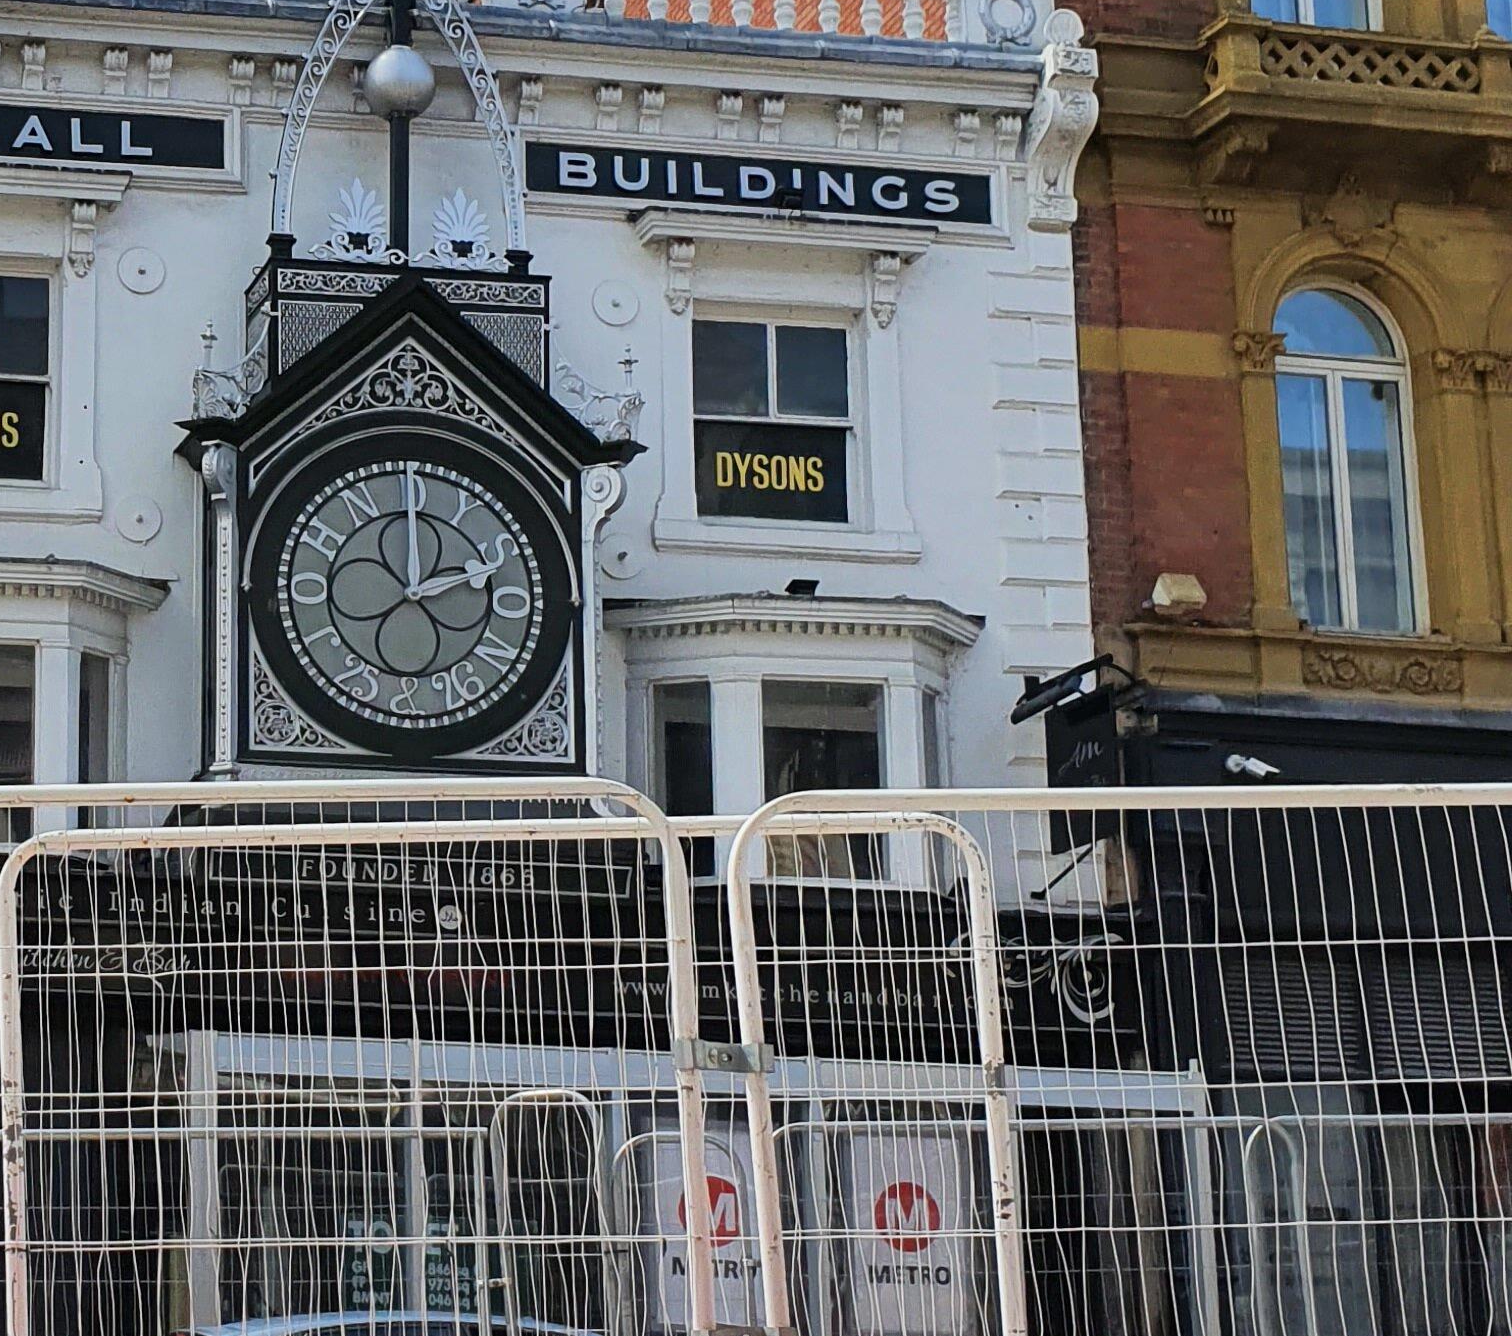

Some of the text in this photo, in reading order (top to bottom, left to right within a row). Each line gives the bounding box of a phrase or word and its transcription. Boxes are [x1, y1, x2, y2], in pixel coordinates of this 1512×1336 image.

[559, 151, 960, 214] BUILDINGS
[716, 451, 825, 492] DYSONS
[332, 654, 379, 703] 25
[389, 676, 425, 715] &
[431, 661, 486, 711] 26
[300, 859, 437, 882] FOUNDED
[108, 890, 240, 916] Indian
[271, 896, 426, 924] Cusine
[672, 1256, 757, 1281] MTRO
[868, 1264, 952, 1285] METRO
